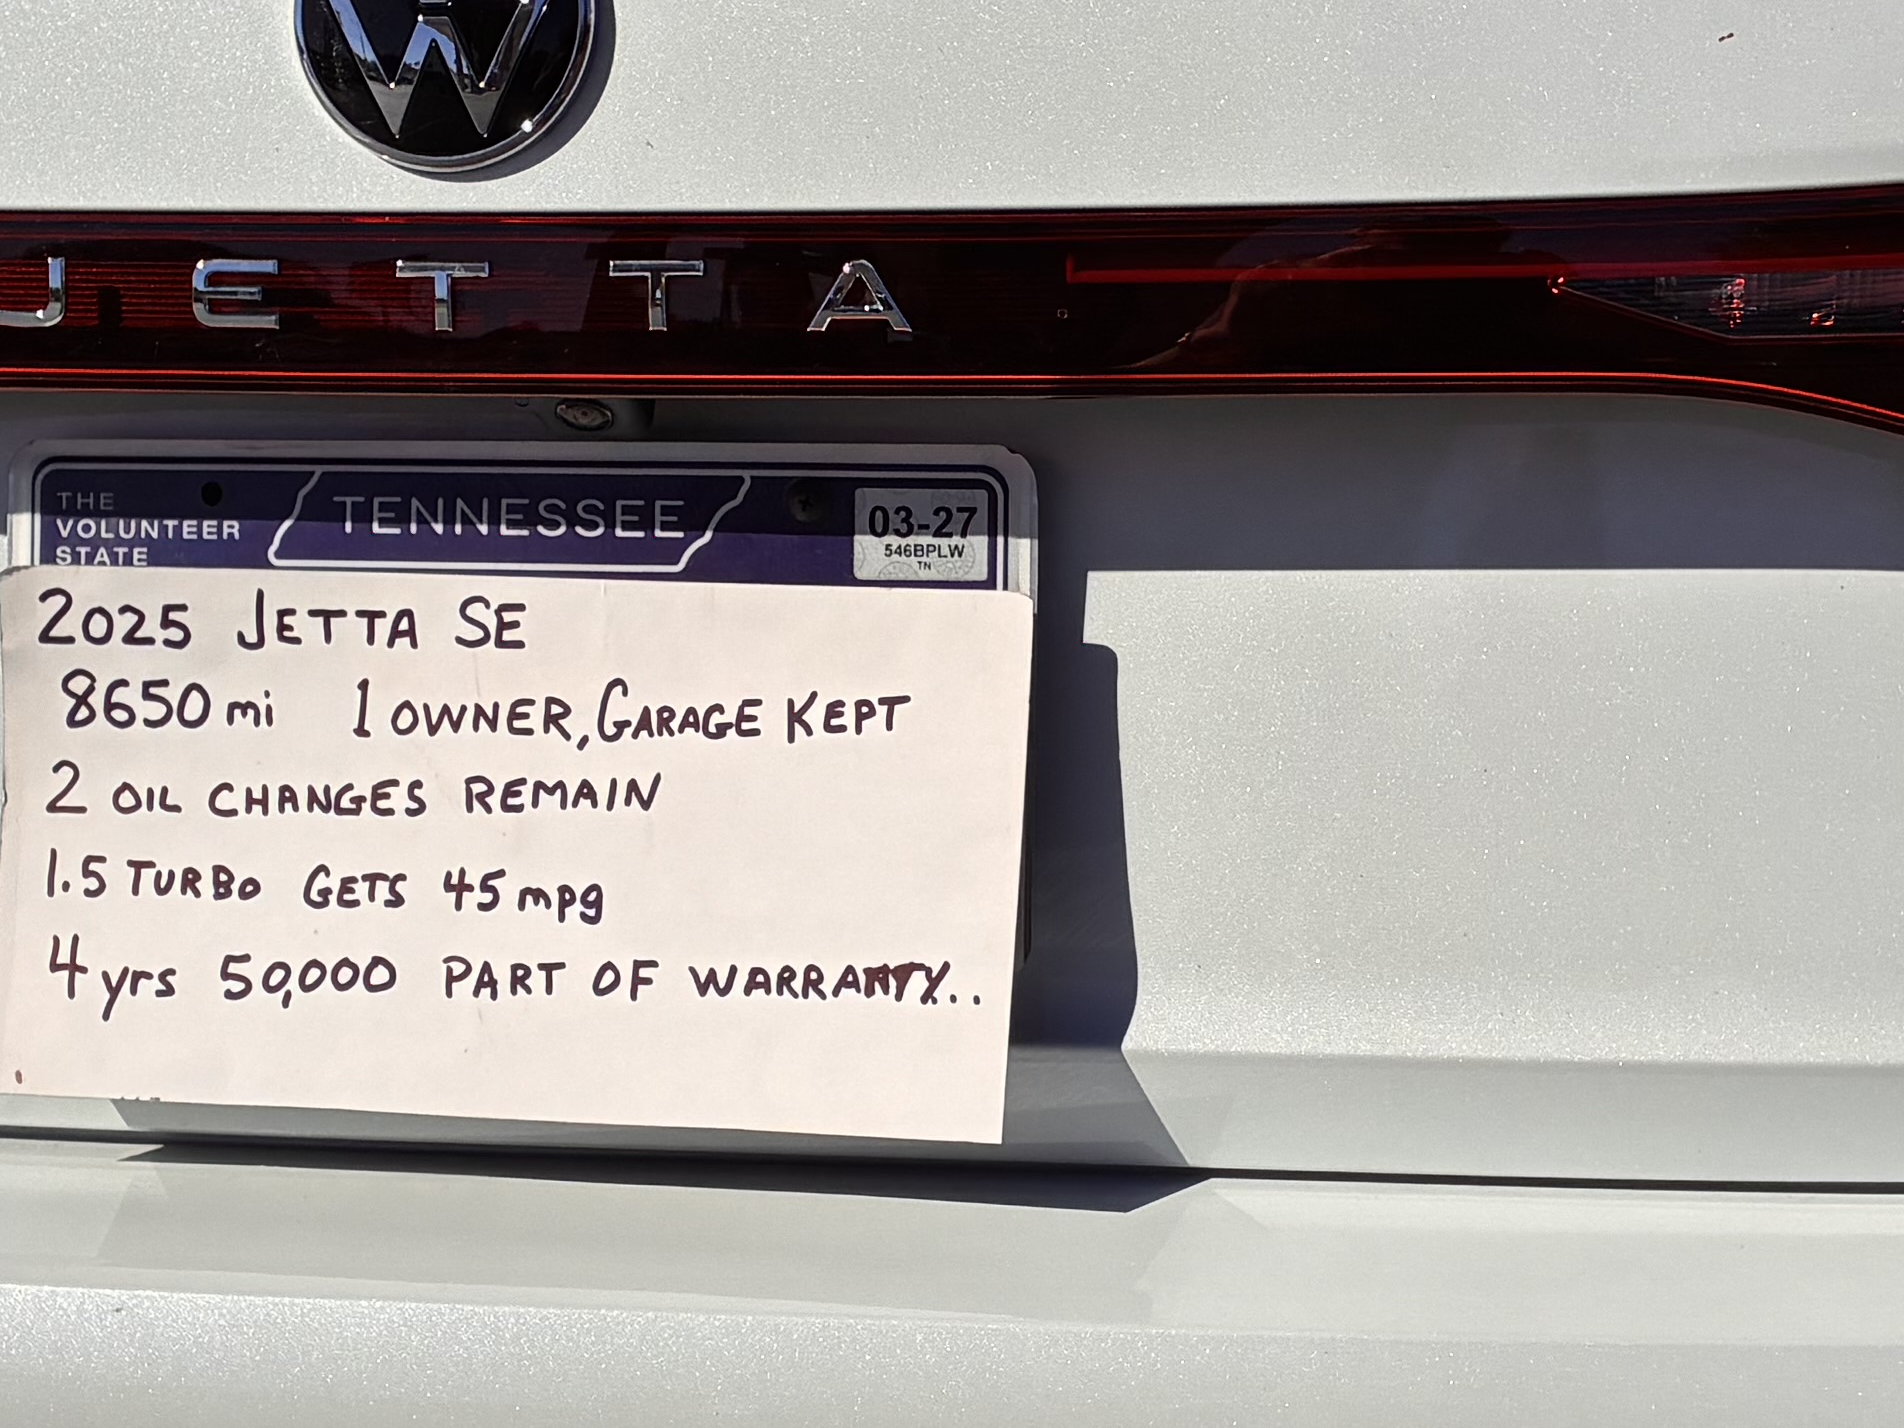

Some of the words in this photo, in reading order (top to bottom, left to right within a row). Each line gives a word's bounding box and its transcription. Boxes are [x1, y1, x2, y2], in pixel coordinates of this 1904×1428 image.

[56, 491, 114, 511] THE
[332, 496, 686, 538] TENNESSEE
[55, 518, 241, 541] VOLUNTEER
[868, 504, 978, 539] 03-27
[55, 546, 149, 567] STATE
[884, 543, 965, 559] 546BPLW
[916, 561, 932, 571] TN
[37, 587, 192, 650] 2025
[236, 587, 419, 651] JETTA
[454, 595, 527, 650] SE
[61, 668, 212, 730] 8650
[226, 689, 274, 728] mi
[352, 677, 372, 738] 1
[787, 690, 912, 745] KEPT
[45, 759, 88, 814] 2
[112, 781, 183, 815] OIL
[208, 778, 427, 818] CHANGES
[464, 771, 662, 815] REMAIN
[46, 847, 108, 899] 1.5
[302, 863, 408, 910] GETS
[443, 866, 507, 913] 45
[517, 883, 604, 926] mpg
[48, 933, 89, 1000] 4
[101, 965, 177, 1022] yrs
[219, 953, 397, 1009] 50,000
[442, 955, 567, 1002] PART
[592, 959, 660, 1002] OF
